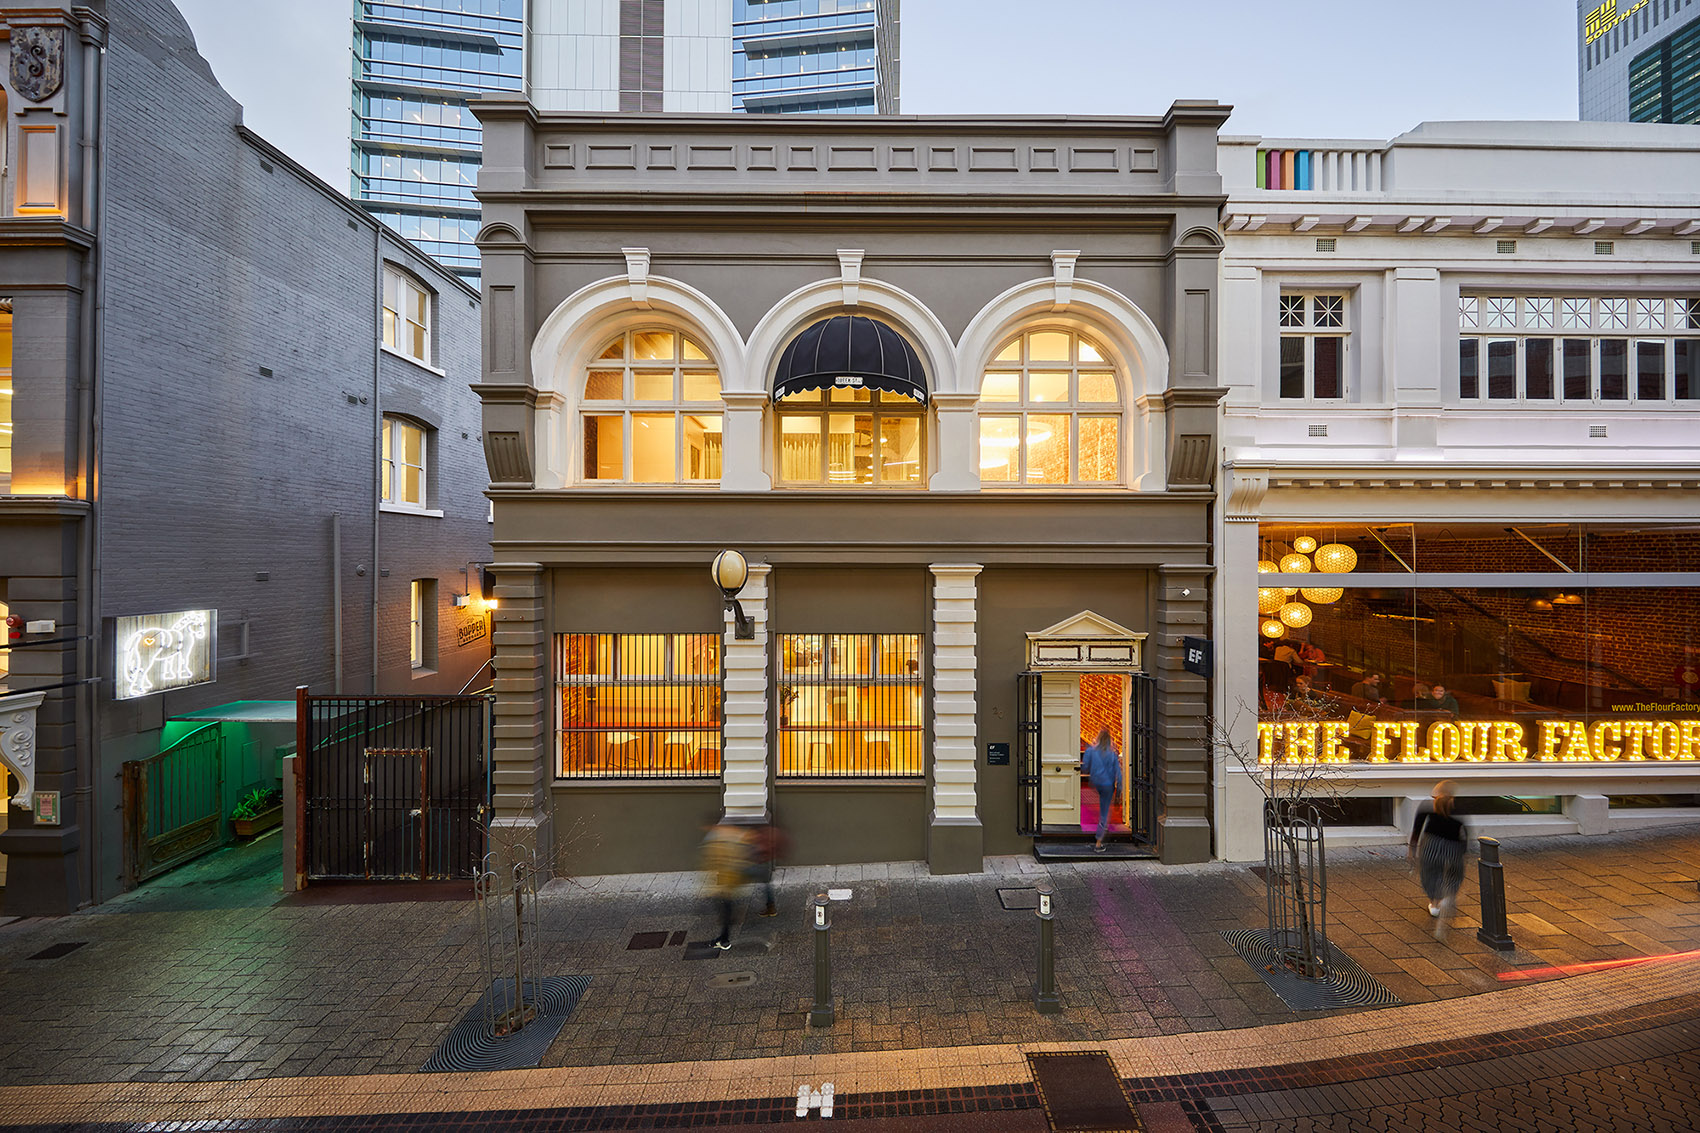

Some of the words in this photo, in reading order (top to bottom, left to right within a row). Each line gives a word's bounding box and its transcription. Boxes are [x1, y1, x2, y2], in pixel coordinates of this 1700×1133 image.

[1586, 0, 1649, 45] SOUTH32
[1188, 648, 1202, 664] EF
[1258, 721, 1349, 763] THE
[1371, 721, 1527, 762] FLOUR
